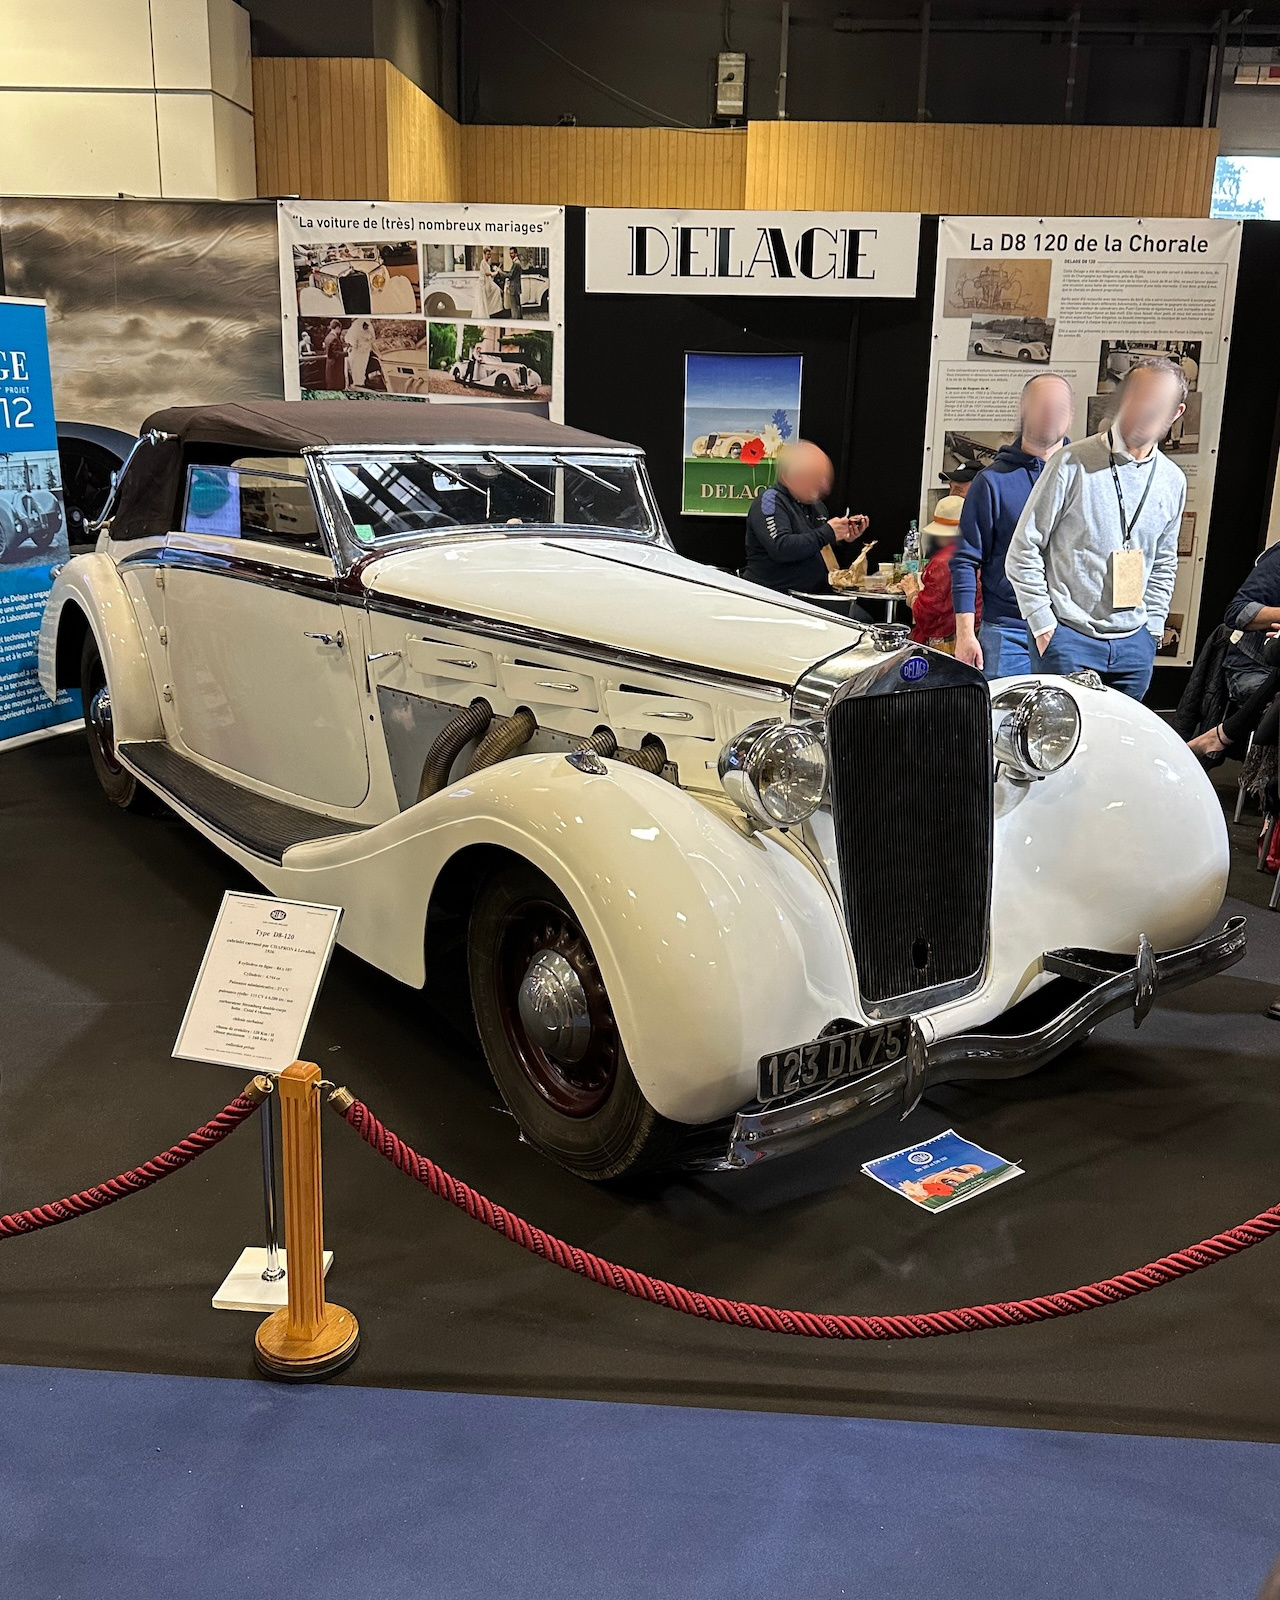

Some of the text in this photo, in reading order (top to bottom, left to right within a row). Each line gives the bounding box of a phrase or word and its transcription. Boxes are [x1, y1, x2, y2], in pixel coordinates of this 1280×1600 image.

[316, 217, 360, 229] voiture
[363, 217, 378, 229] de
[381, 217, 414, 231] (très)
[419, 218, 482, 232] nombreux
[970, 233, 1208, 253] La D8 120 de la Chorale
[628, 226, 878, 280] DELAGE
[5, 386, 30, 394] PROJET
[904, 660, 926, 678] DELAGE
[256, 929, 295, 940] Type D8-120
[768, 1045, 820, 1096] 123
